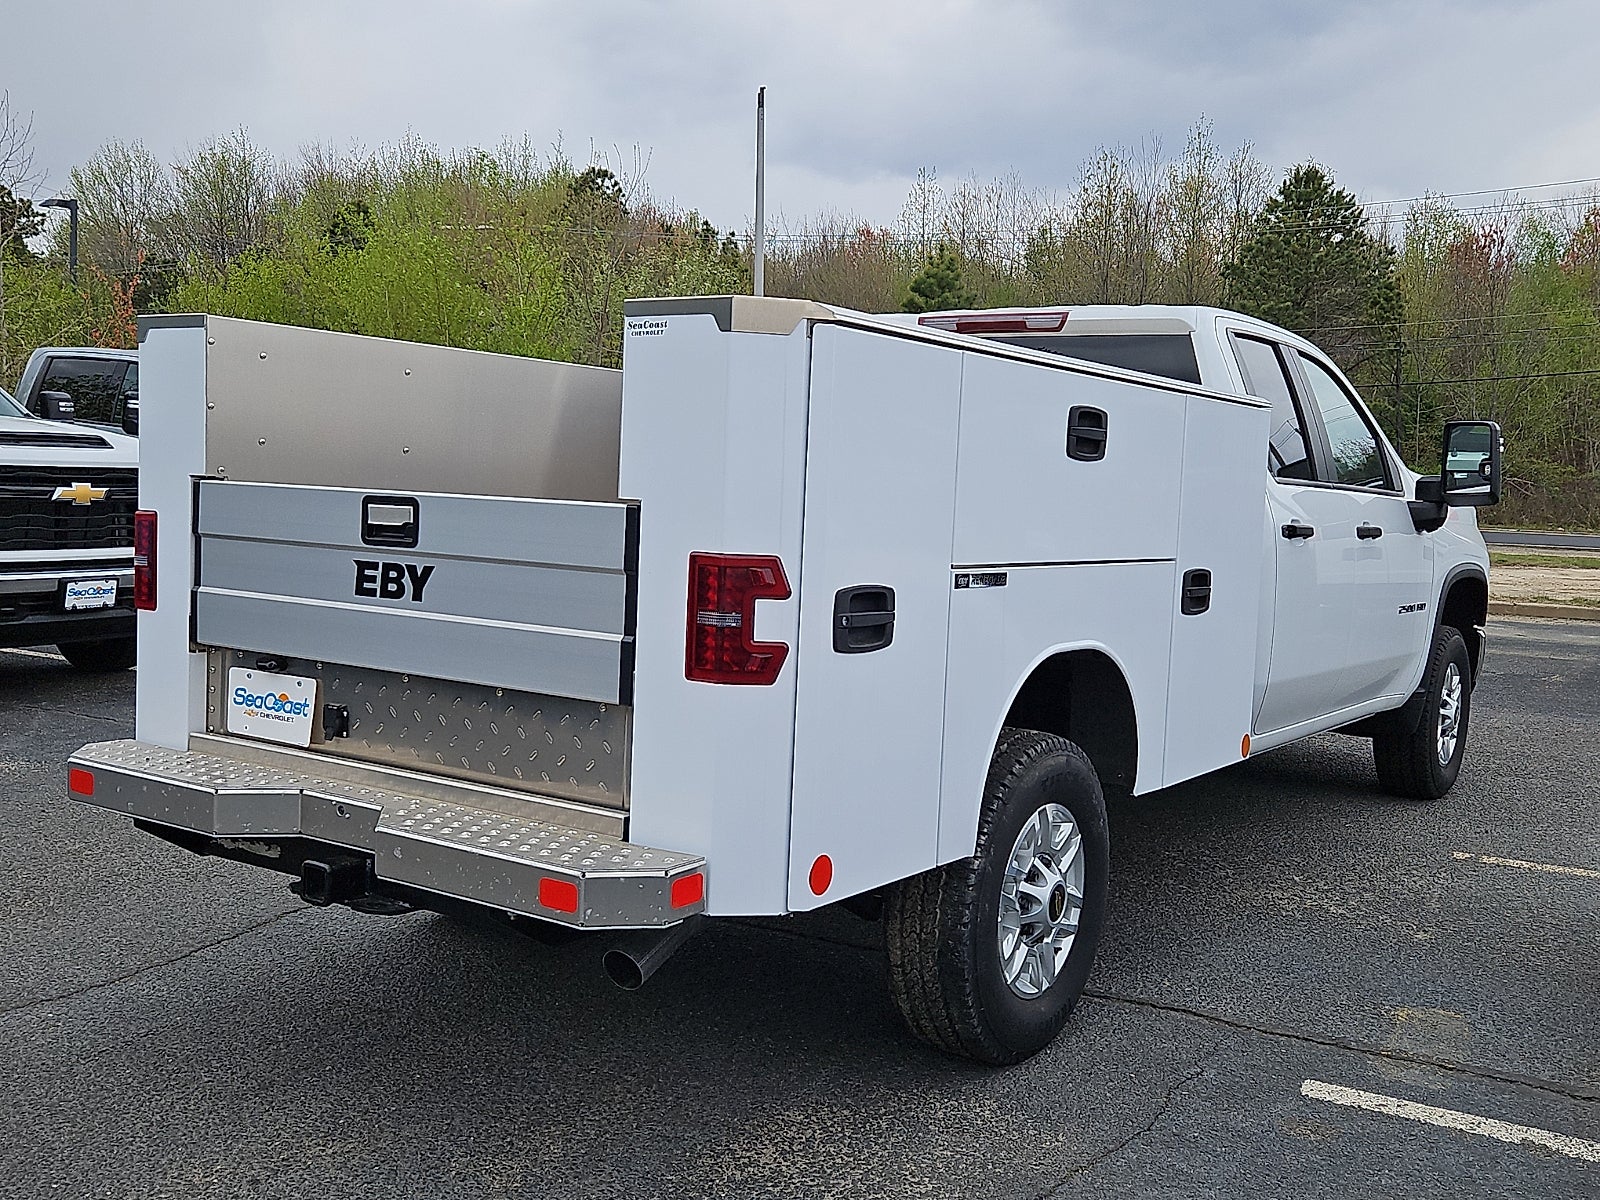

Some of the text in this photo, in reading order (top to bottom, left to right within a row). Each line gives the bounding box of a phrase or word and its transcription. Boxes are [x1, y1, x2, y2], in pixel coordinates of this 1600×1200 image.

[627, 320, 668, 330] SeaCoast
[352, 559, 436, 603] EBY
[67, 586, 115, 597] SeaCoast
[233, 687, 310, 717] SeaCoast
[259, 711, 295, 723] CHEVROLET
